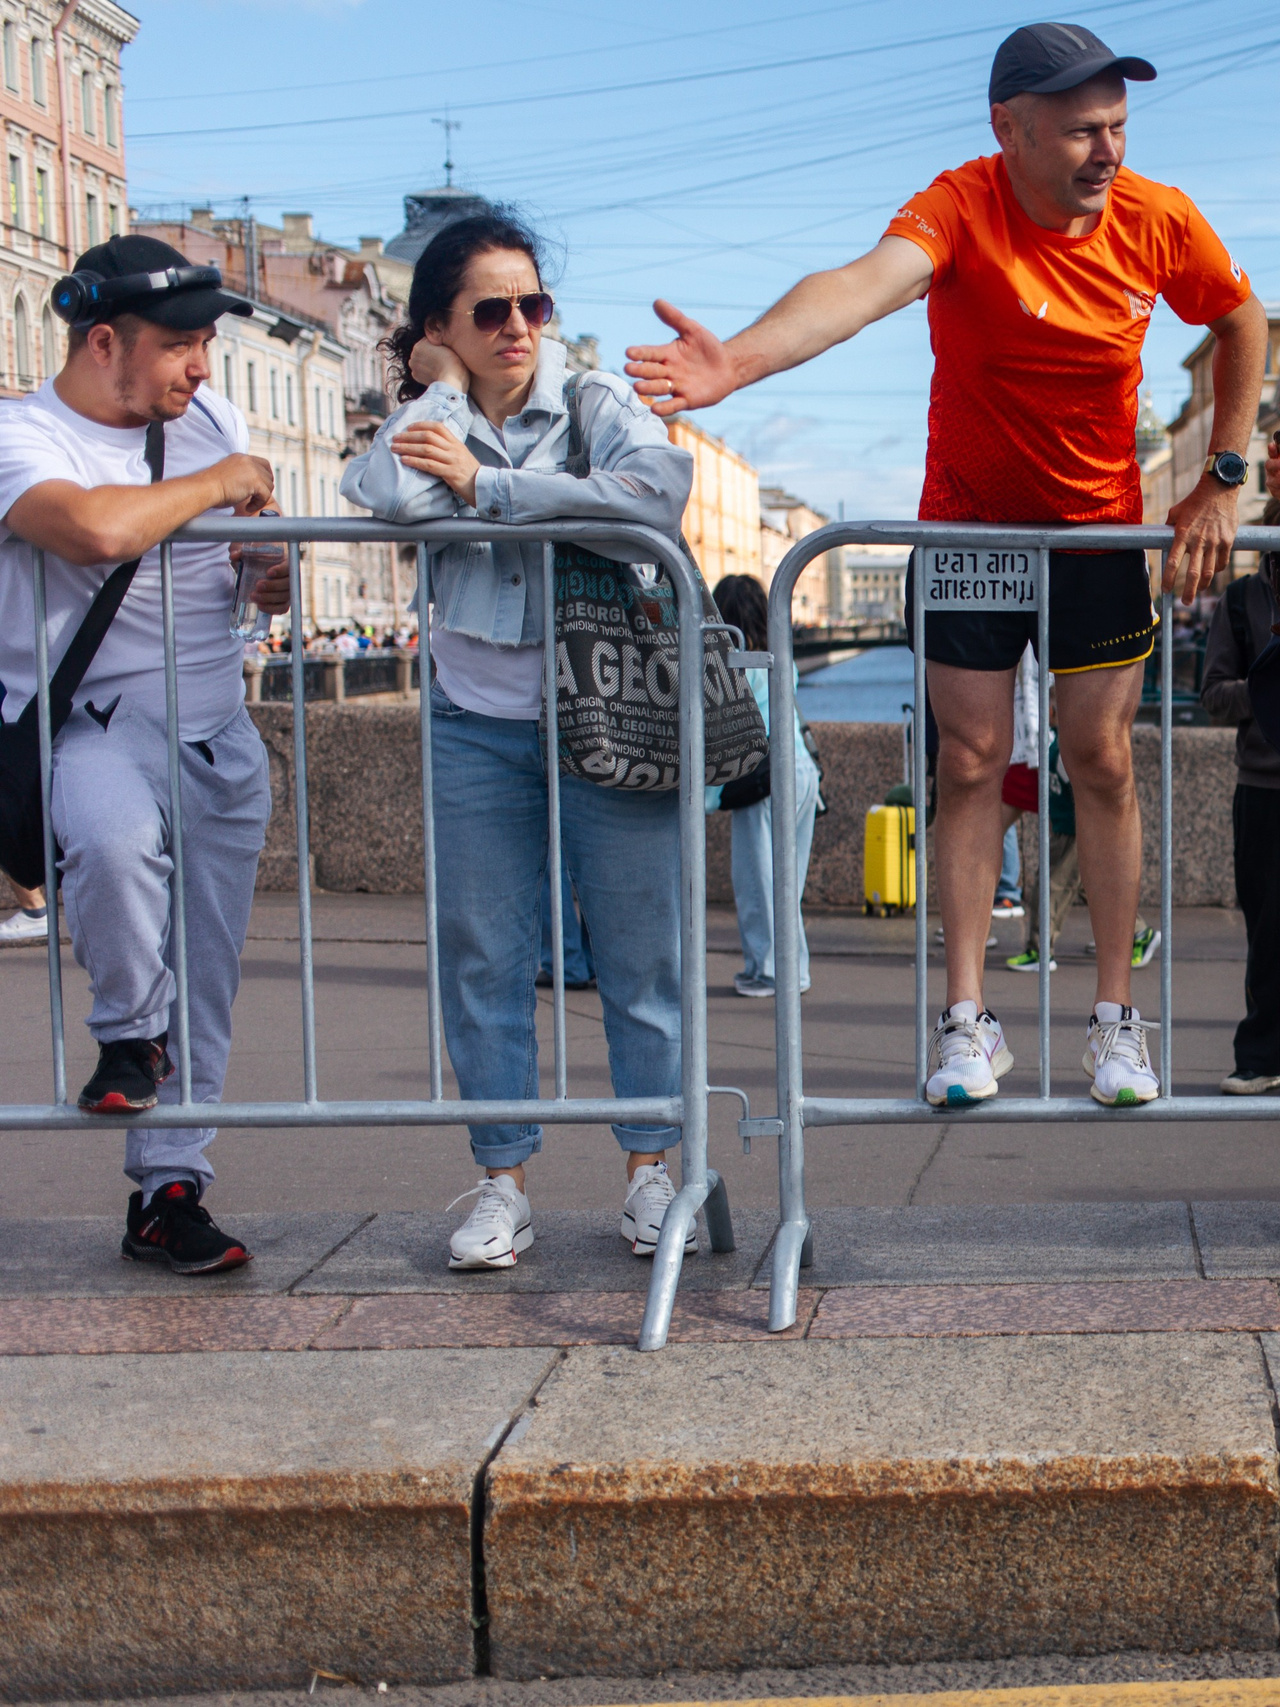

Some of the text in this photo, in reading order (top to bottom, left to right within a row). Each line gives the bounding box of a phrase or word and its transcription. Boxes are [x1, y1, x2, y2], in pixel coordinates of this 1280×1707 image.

[916, 222, 938, 238] RUN
[609, 702, 652, 718] ORIGINAL
[622, 719, 675, 736] GEORGIA
